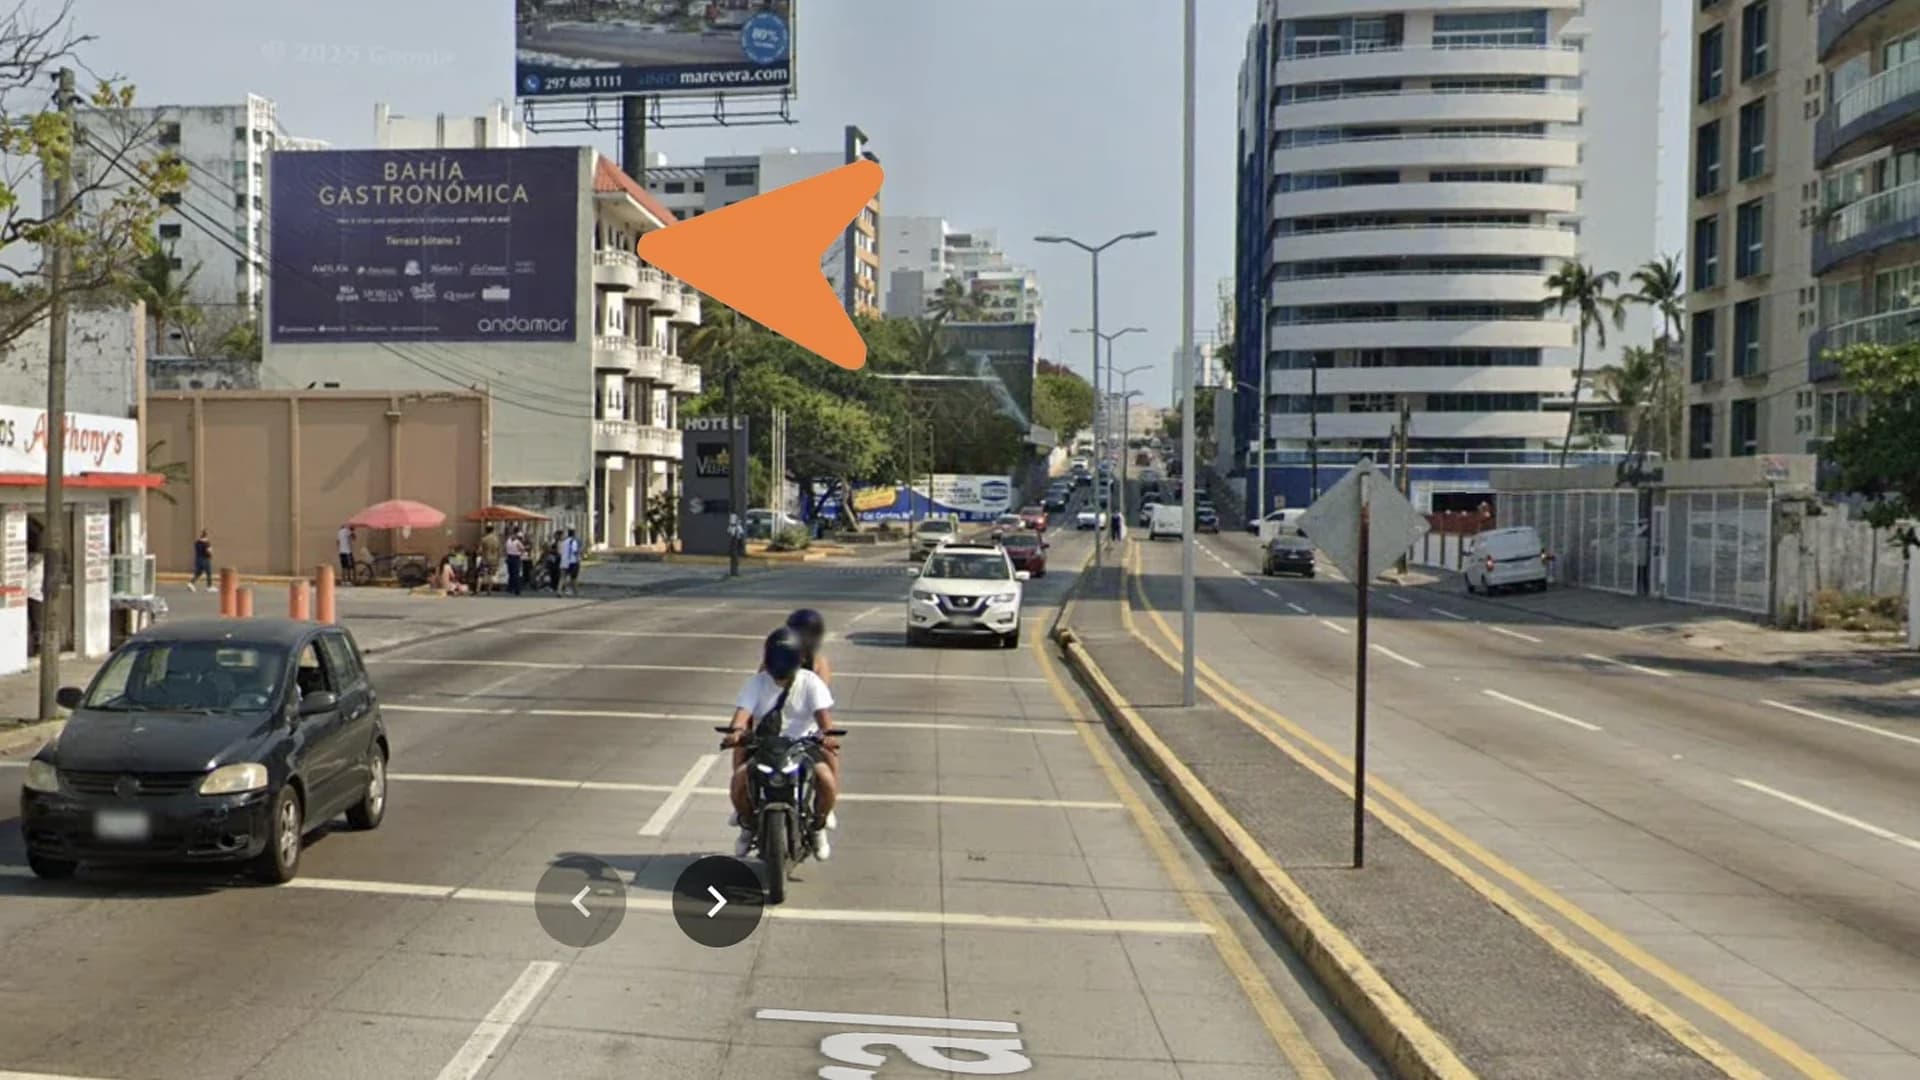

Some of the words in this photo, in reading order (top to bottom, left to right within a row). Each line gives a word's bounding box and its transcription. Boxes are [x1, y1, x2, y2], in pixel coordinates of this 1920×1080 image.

[545, 78, 567, 91] 297
[594, 75, 622, 89] 1111
[680, 67, 788, 84] marevera.com
[384, 157, 464, 182] BAHÍA
[319, 180, 529, 205] GASTRONÓMICA
[386, 236, 419, 246] Terraza
[456, 235, 462, 246] 2
[478, 316, 568, 333] andamar
